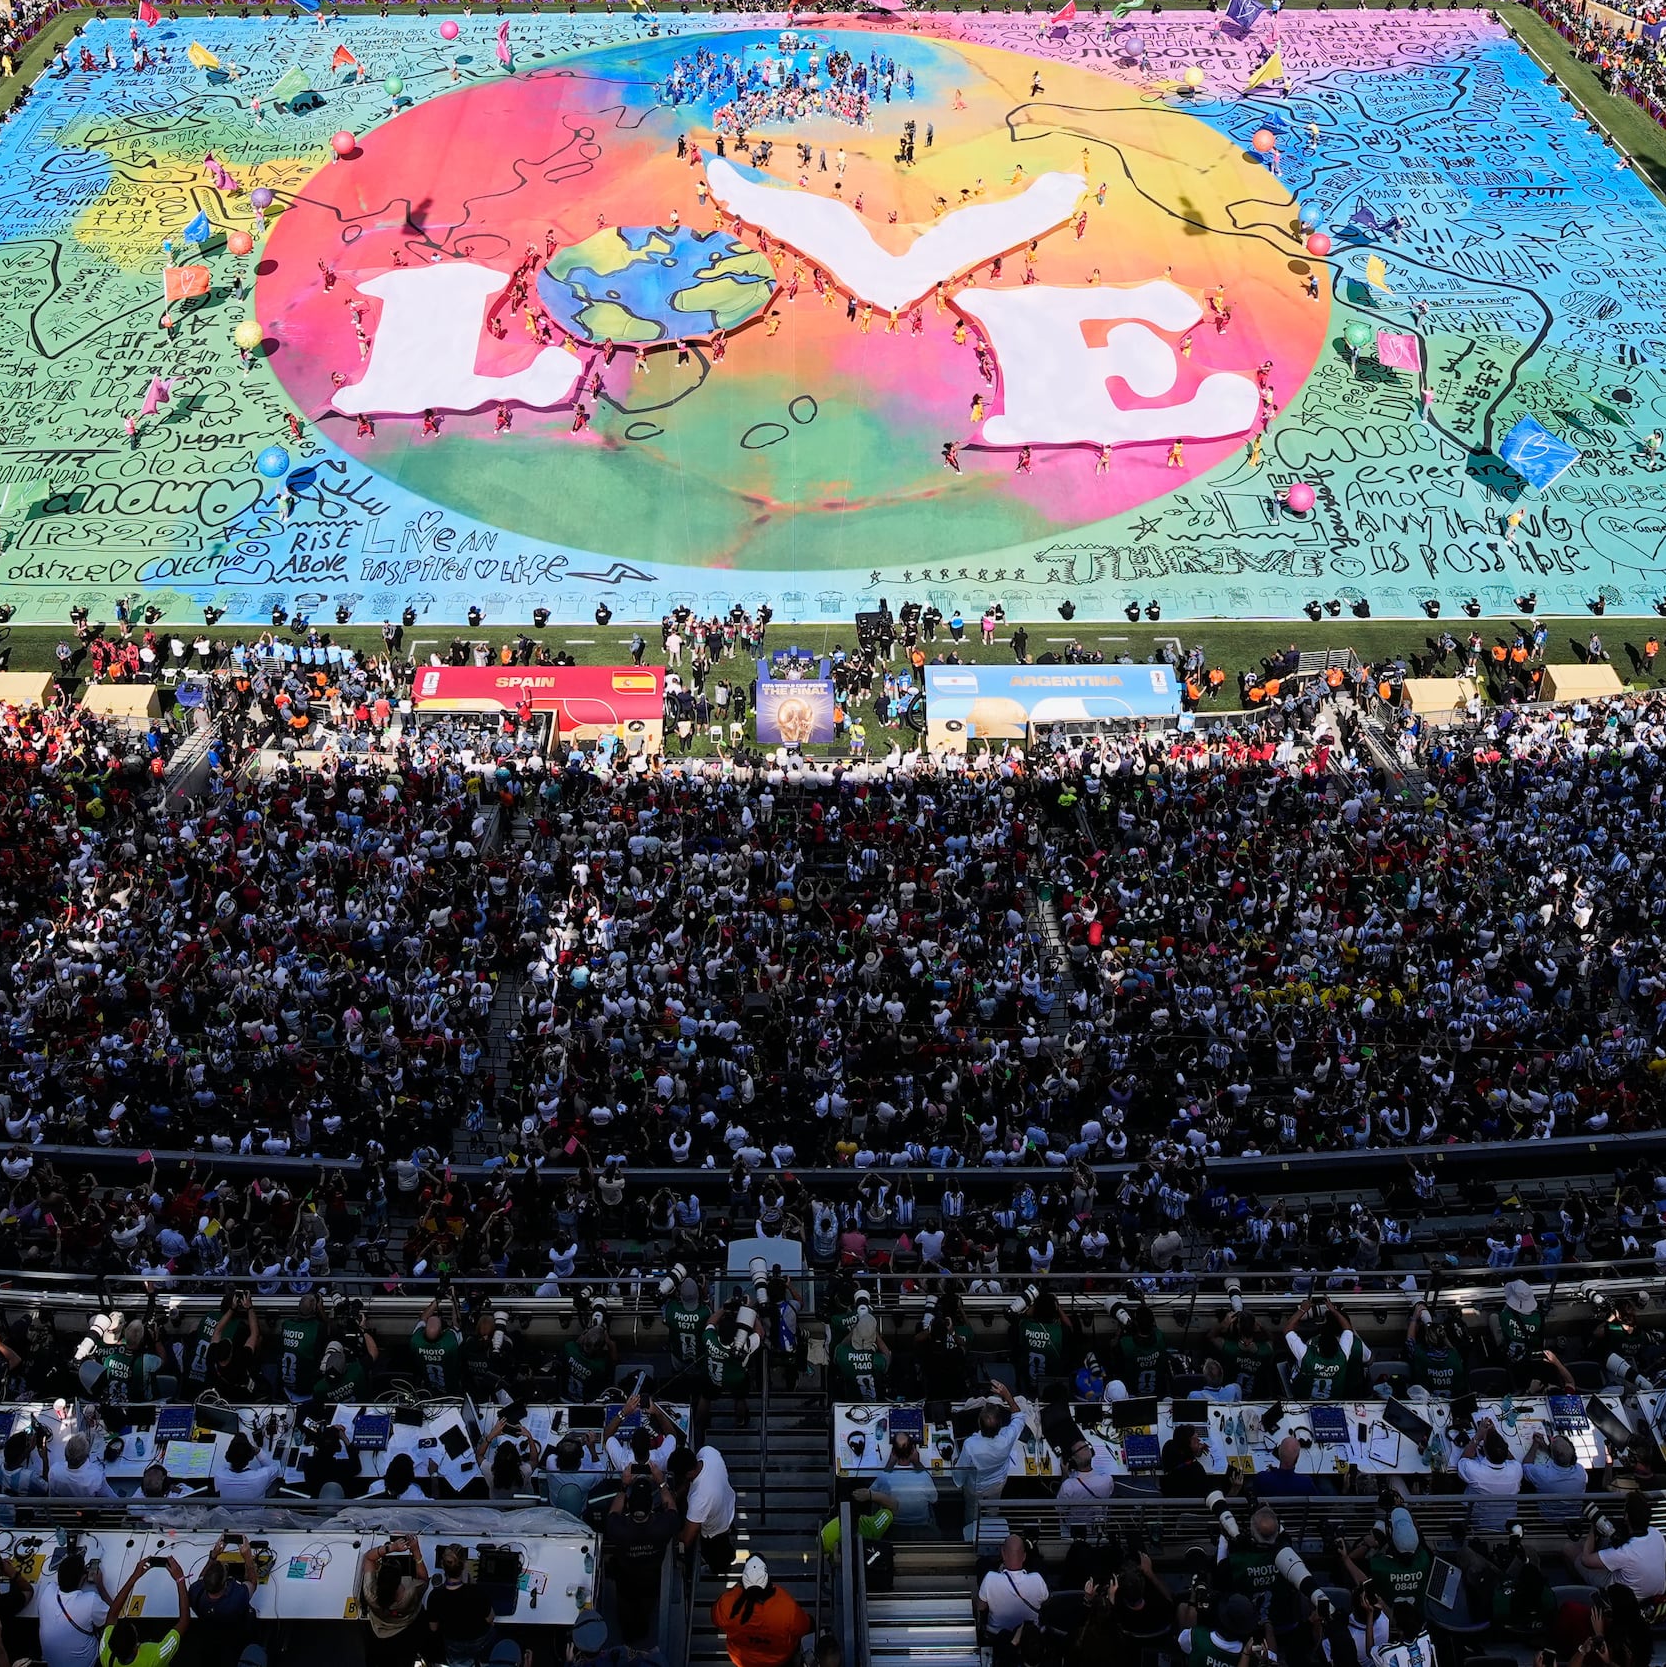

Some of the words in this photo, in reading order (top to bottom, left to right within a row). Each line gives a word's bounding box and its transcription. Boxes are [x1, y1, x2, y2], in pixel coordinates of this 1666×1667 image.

[1334, 72, 1411, 85] GLOBAL
[1351, 83, 1451, 93] CITIZEN
[223, 140, 324, 154] educación
[1412, 187, 1431, 199] BY
[1437, 187, 1473, 199] LOVE
[1346, 482, 1440, 510] Amor
[1034, 543, 1326, 585] THRIVE
[495, 676, 555, 688] SPAIN
[1009, 676, 1124, 687] ARGENTINA
[284, 1330, 308, 1340] PHOTO
[1026, 1329, 1051, 1339] PHOTO
[419, 1348, 447, 1356] PHOTO
[848, 1353, 873, 1361] PHOTO
[1428, 1368, 1456, 1378] PHOTO
[1392, 1573, 1426, 1583] PHOTO
